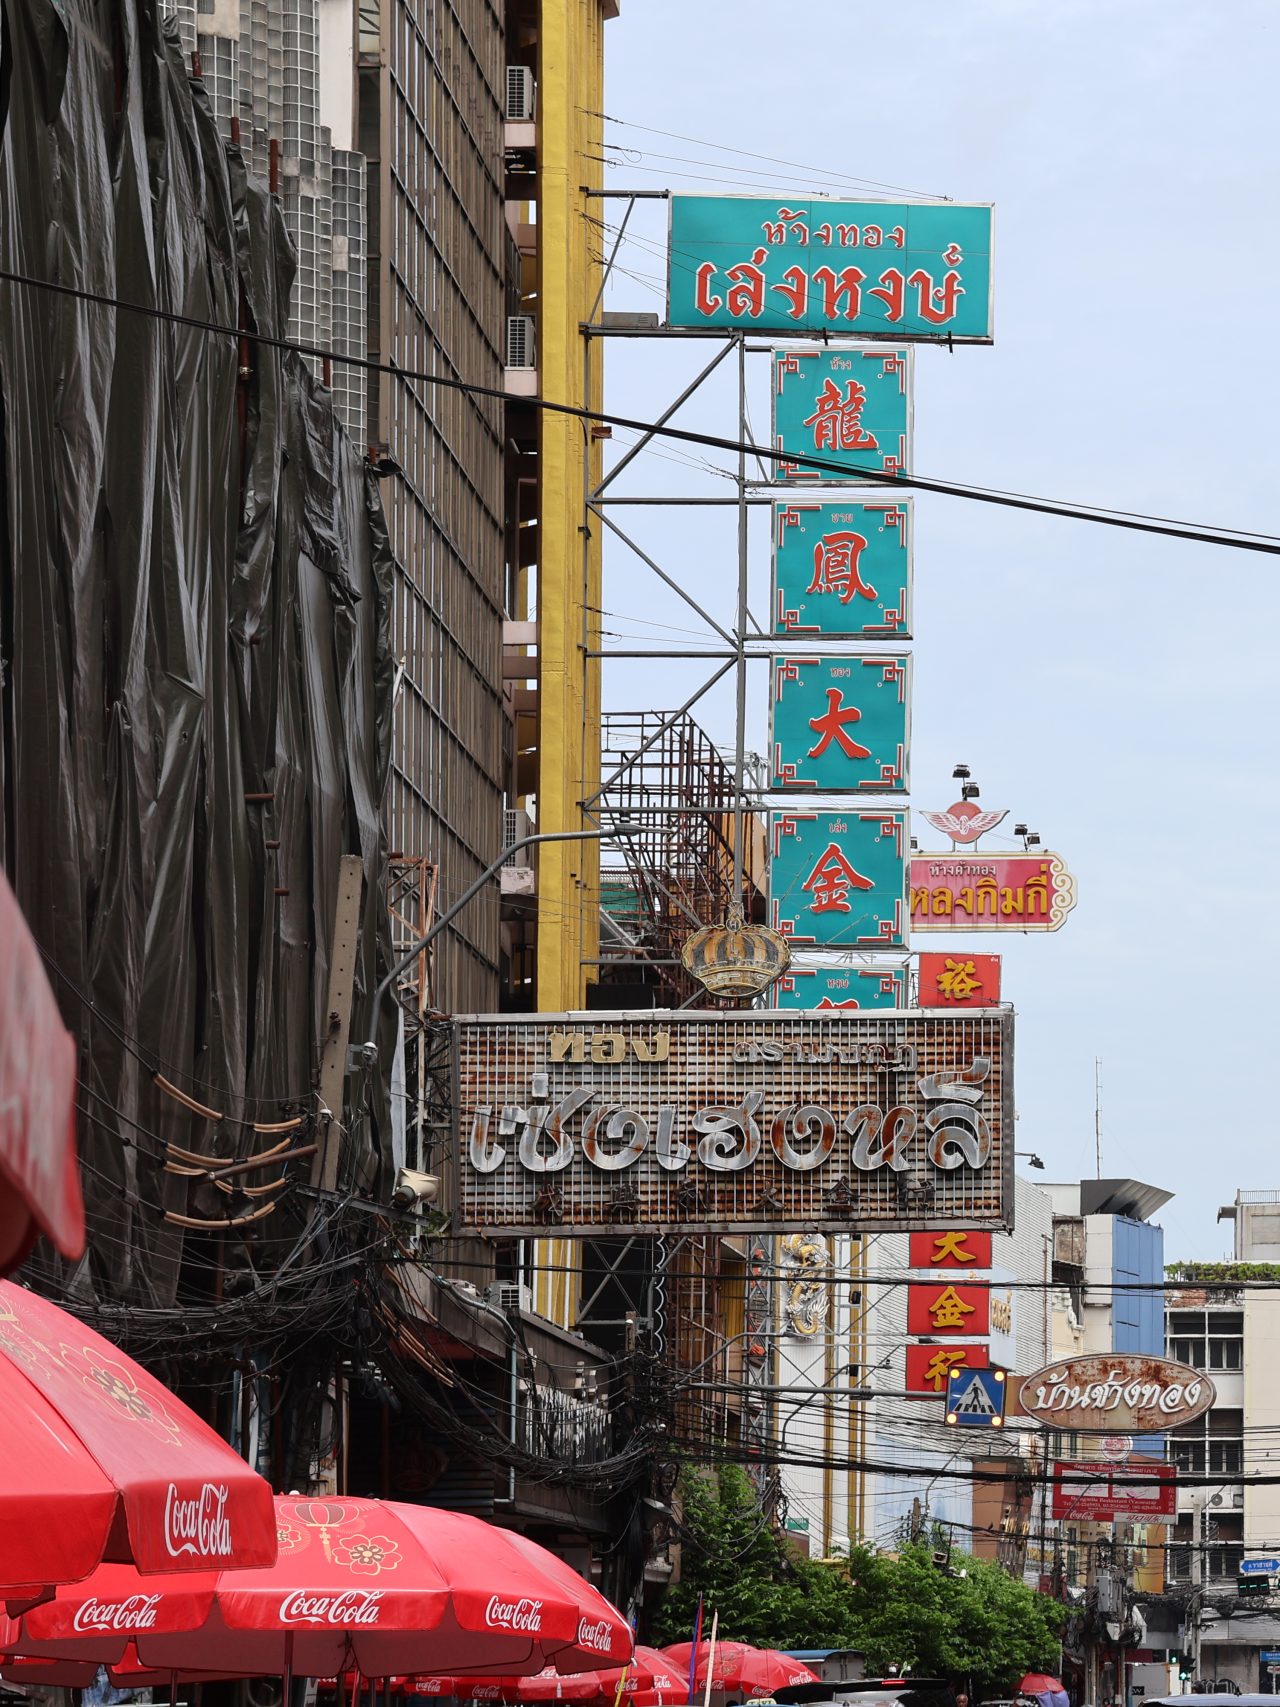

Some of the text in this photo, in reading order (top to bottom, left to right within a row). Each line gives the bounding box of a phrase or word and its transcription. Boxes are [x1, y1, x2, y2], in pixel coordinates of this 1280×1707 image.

[762, 208, 905, 249] ห้างทอง
[694, 243, 966, 325] เล่งหงษ์
[803, 378, 879, 451] 龍
[805, 531, 879, 604] 鳳
[806, 688, 872, 760] 大
[802, 842, 875, 914] 金
[929, 861, 997, 877] ห้างค้าทอง
[549, 1032, 671, 1063] ทอง
[931, 1231, 976, 1264] 大
[929, 1285, 976, 1329] 金
[1035, 1370, 1203, 1415] บ้านช้างทอง
[164, 1482, 233, 1557] Coca-Cola
[1069, 1511, 1096, 1520] Coca-Cola
[73, 1593, 164, 1632] Coca-Cola
[279, 1589, 386, 1625] Coca-Cola
[485, 1594, 543, 1632] Coca-Cola
[578, 1616, 612, 1652] Coca-Cola
[416, 1680, 441, 1693] Coca-Cola
[471, 1685, 500, 1699] Coca-Cola
